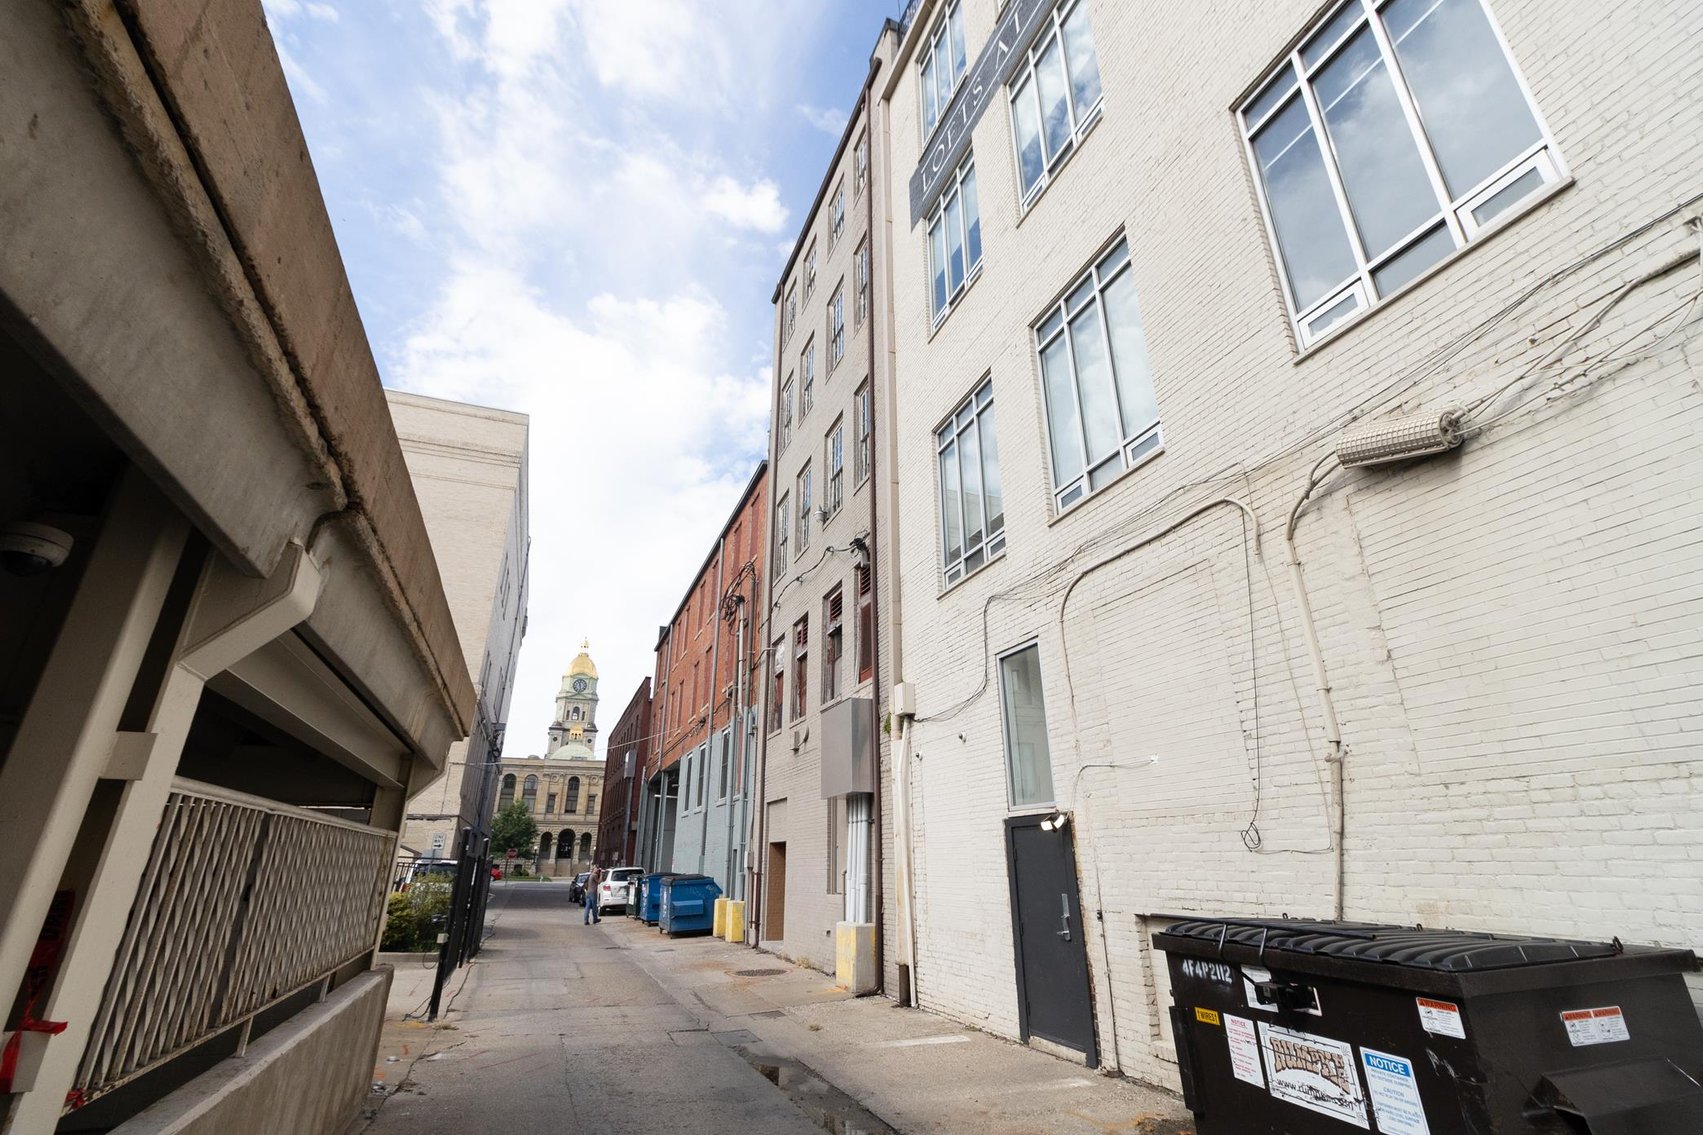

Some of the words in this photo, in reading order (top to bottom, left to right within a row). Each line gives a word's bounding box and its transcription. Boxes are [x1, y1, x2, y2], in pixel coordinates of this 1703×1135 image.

[922, 78, 982, 192] LOFTS
[995, 2, 1023, 69] AT
[1269, 1036, 1351, 1095] RUMPKE
[1369, 1055, 1406, 1075] NOTICE
